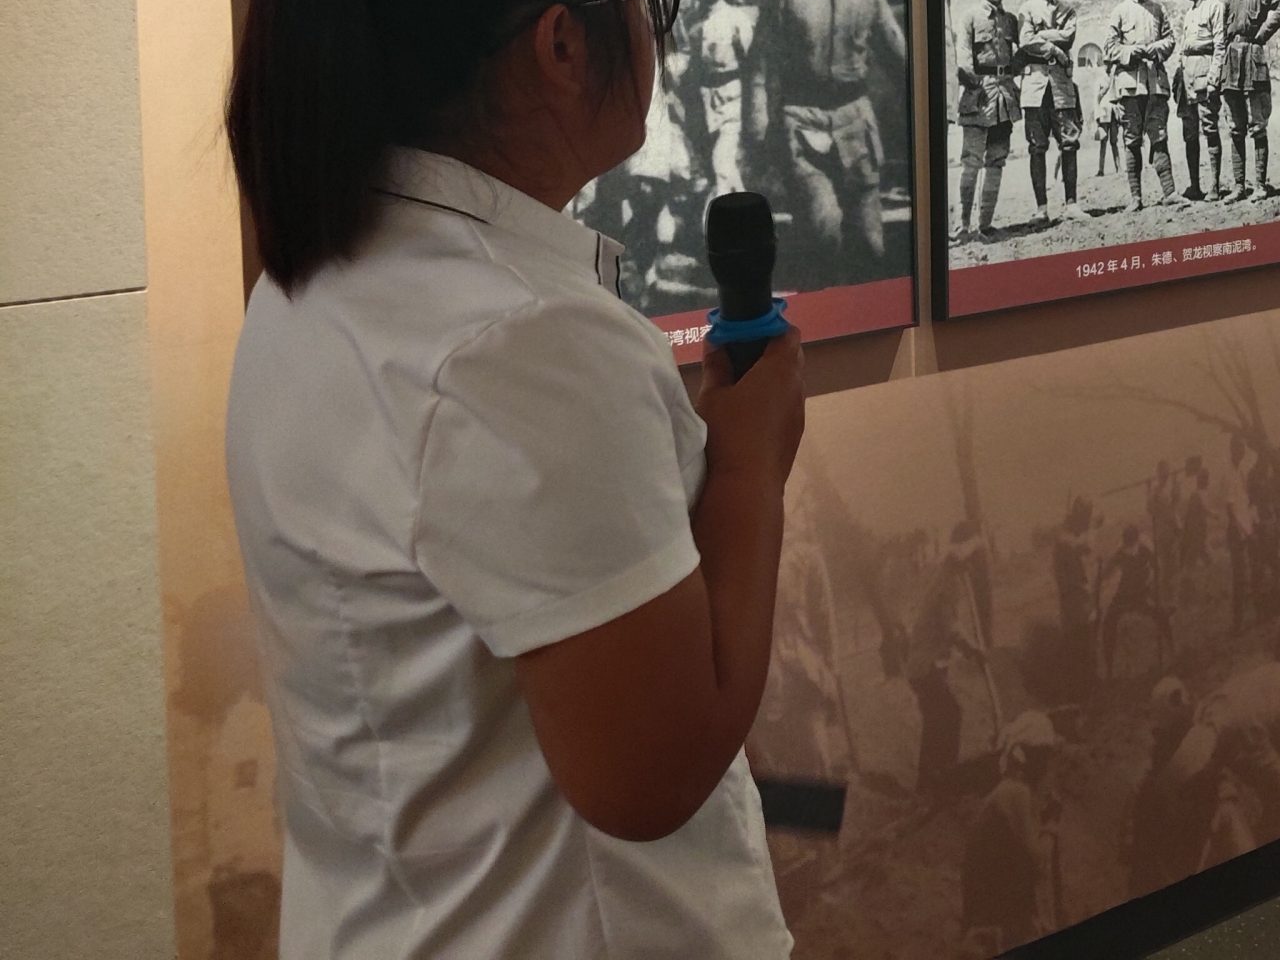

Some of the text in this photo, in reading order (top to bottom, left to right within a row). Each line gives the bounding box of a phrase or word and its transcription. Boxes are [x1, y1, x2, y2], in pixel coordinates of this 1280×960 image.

[1076, 238, 1257, 278] 1942年4月，朱德、贺龙视察南泥湾。
